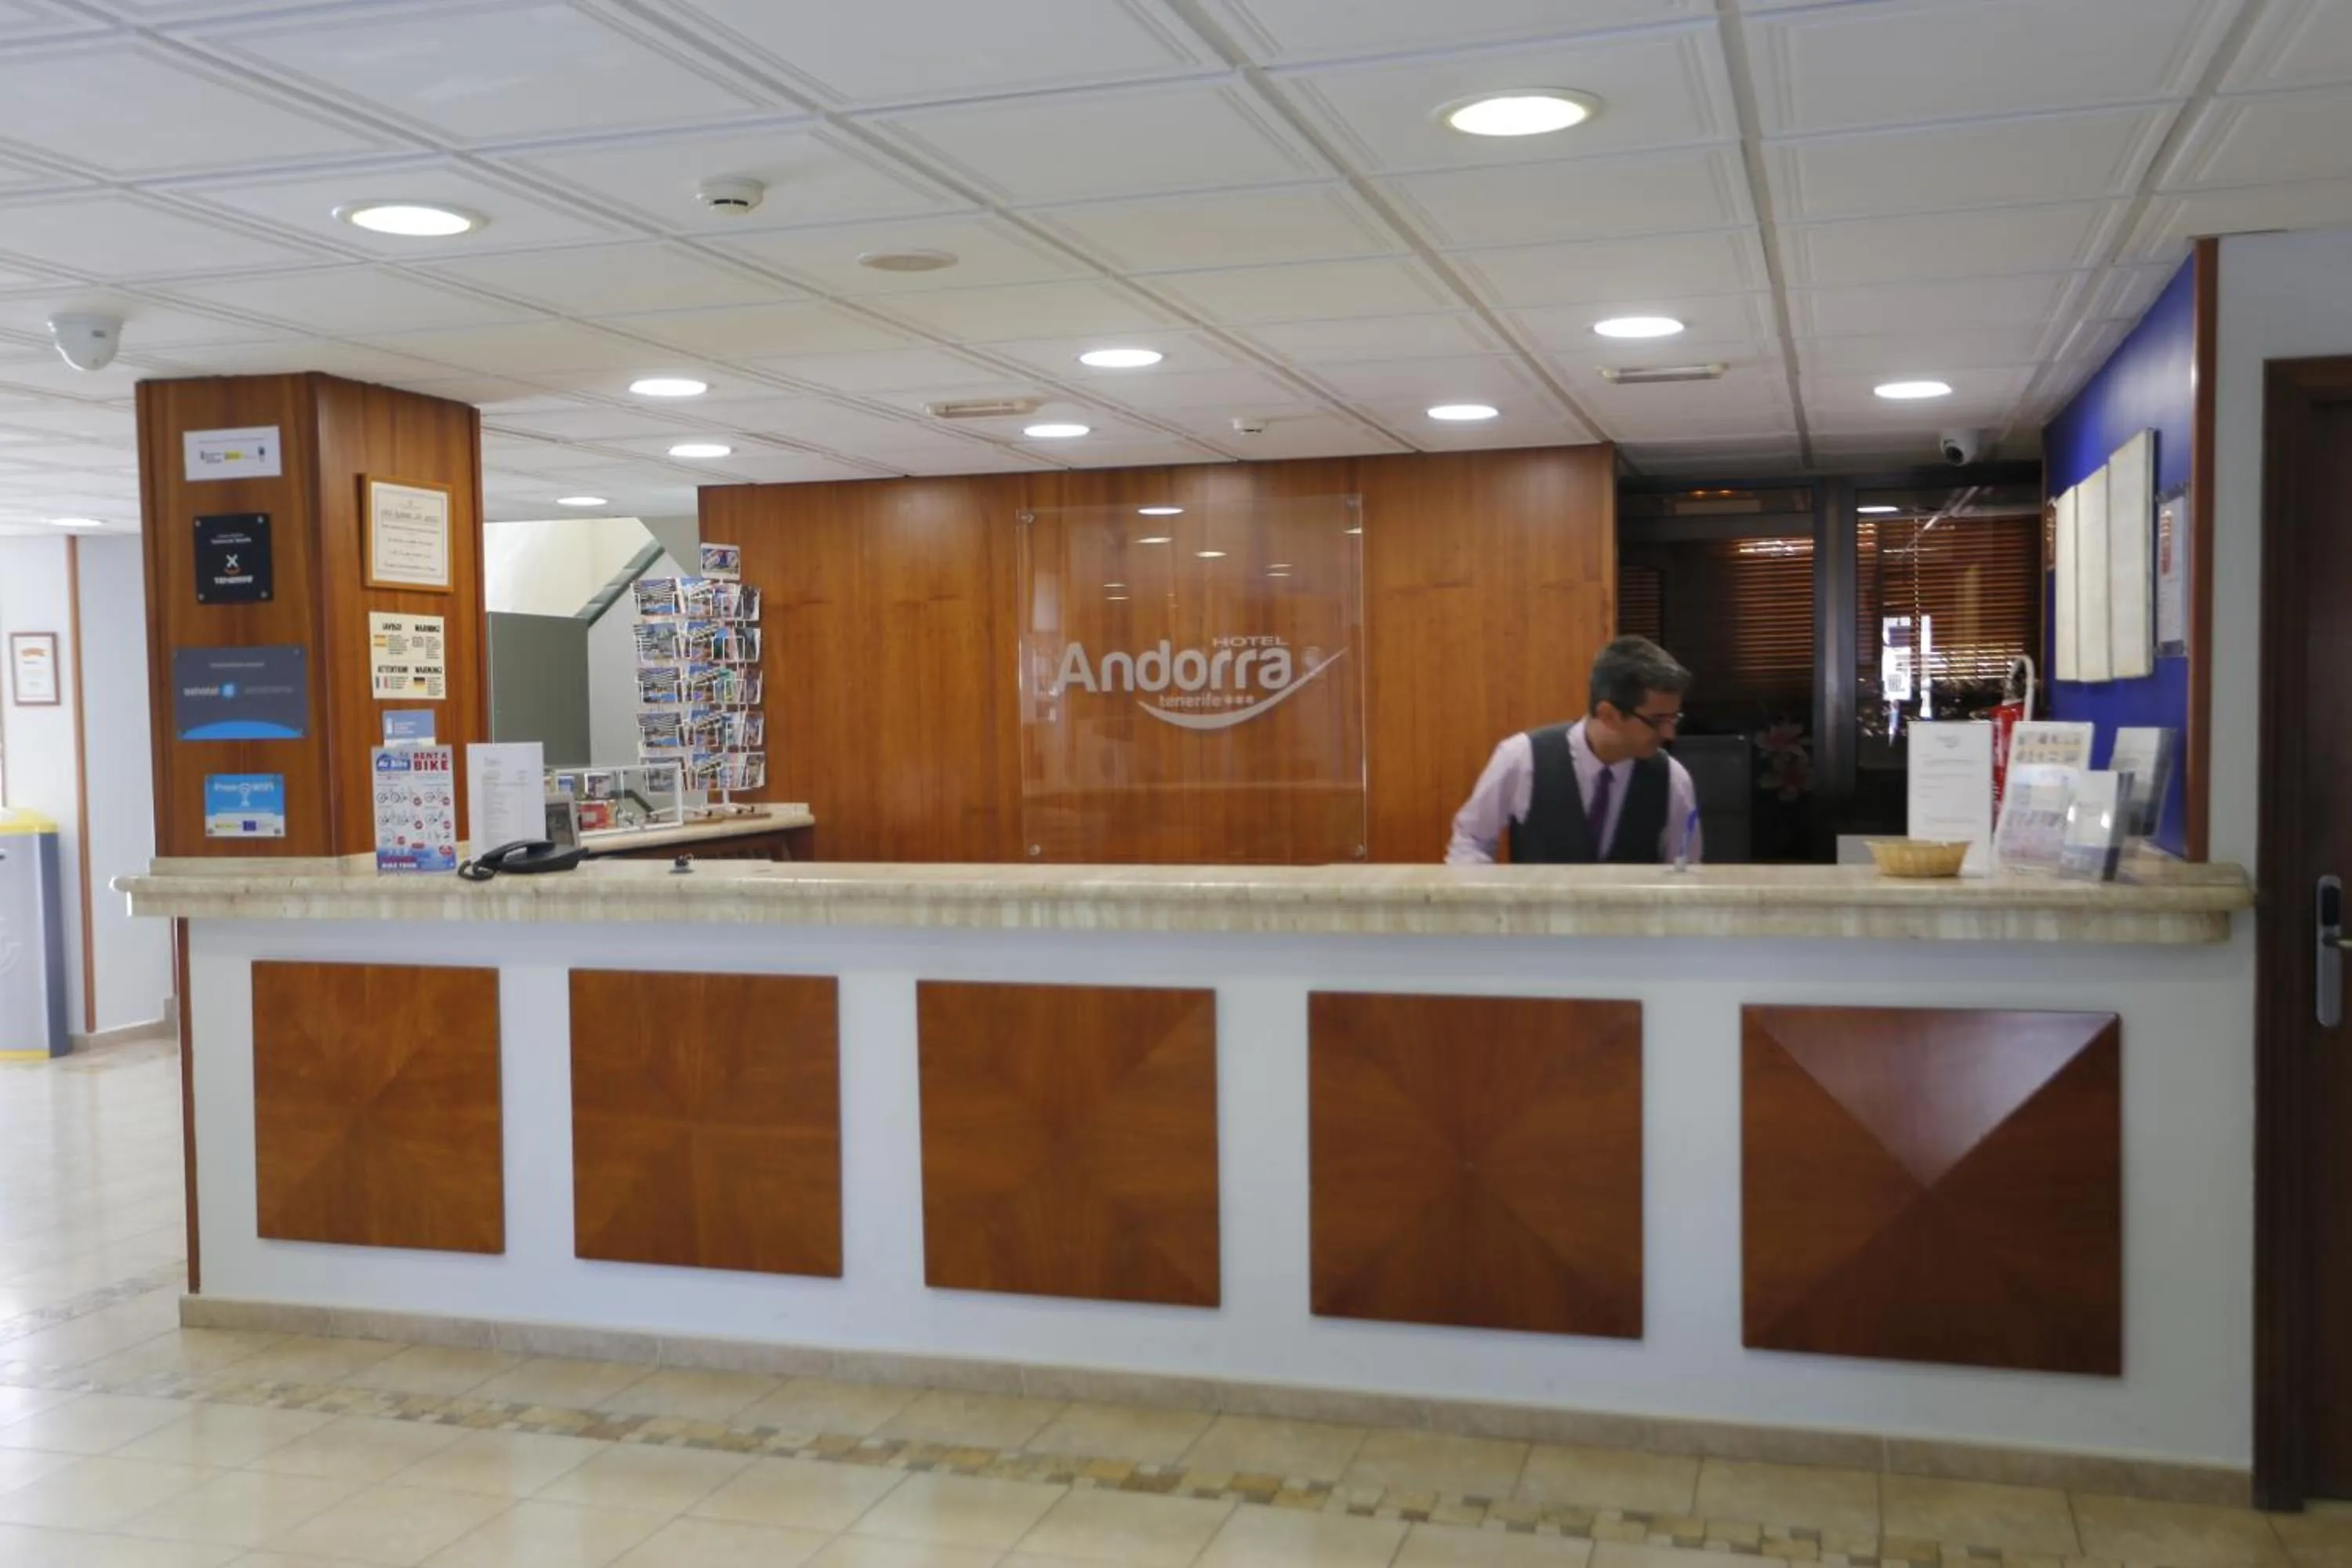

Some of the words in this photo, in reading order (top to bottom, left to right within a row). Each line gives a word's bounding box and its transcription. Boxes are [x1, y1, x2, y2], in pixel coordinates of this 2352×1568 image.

[1211, 636, 1290, 647] HOTEL
[1057, 639, 1292, 693] Andorra
[1159, 694, 1221, 708] tenerife
[413, 760, 449, 771] BIKE
